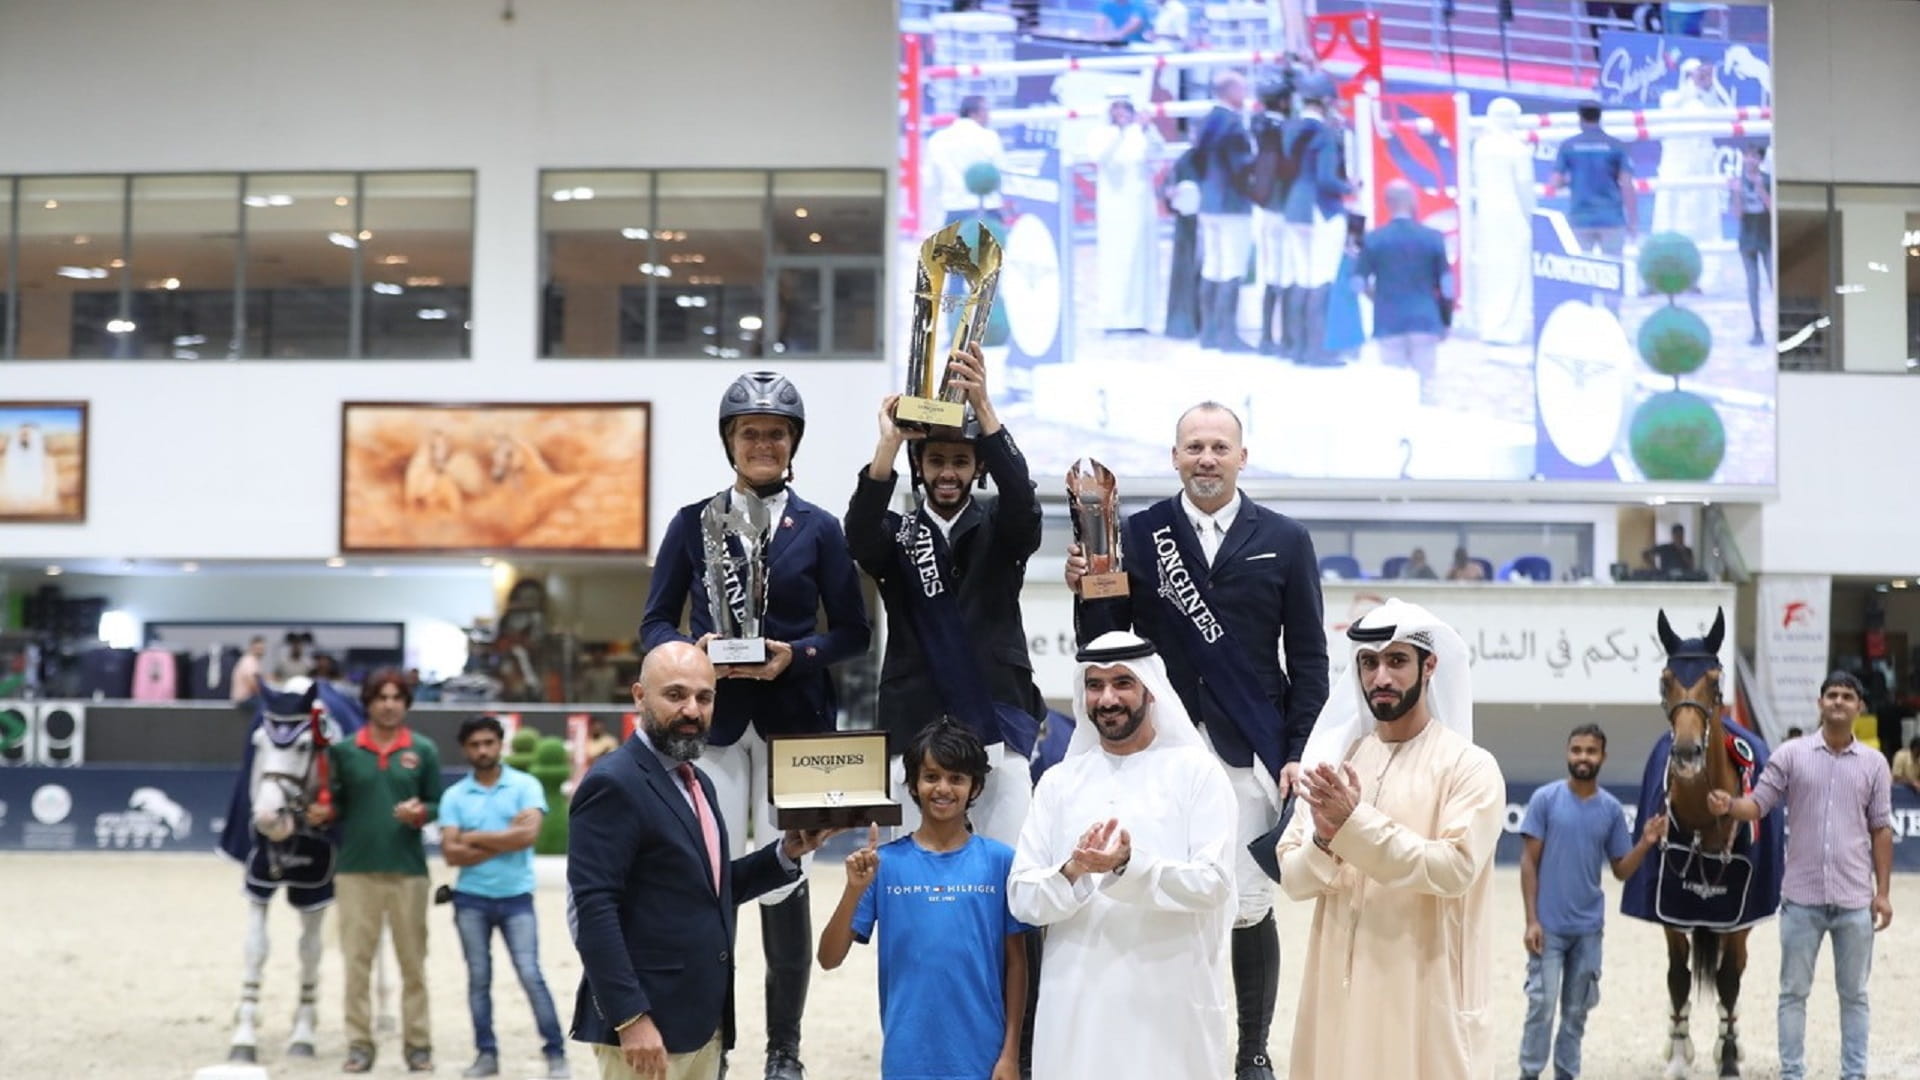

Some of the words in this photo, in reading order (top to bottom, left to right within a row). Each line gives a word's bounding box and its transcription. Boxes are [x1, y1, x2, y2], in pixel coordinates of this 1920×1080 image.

[914, 522, 945, 598] GINES
[1151, 525, 1225, 644] LONGINES
[1468, 630, 1536, 668] الشار
[1545, 628, 1572, 677] في
[1581, 627, 1640, 677] بكم
[791, 753, 865, 768] LONGINES
[886, 885, 931, 895] TOMMY
[947, 884, 996, 894] HILFIGER
